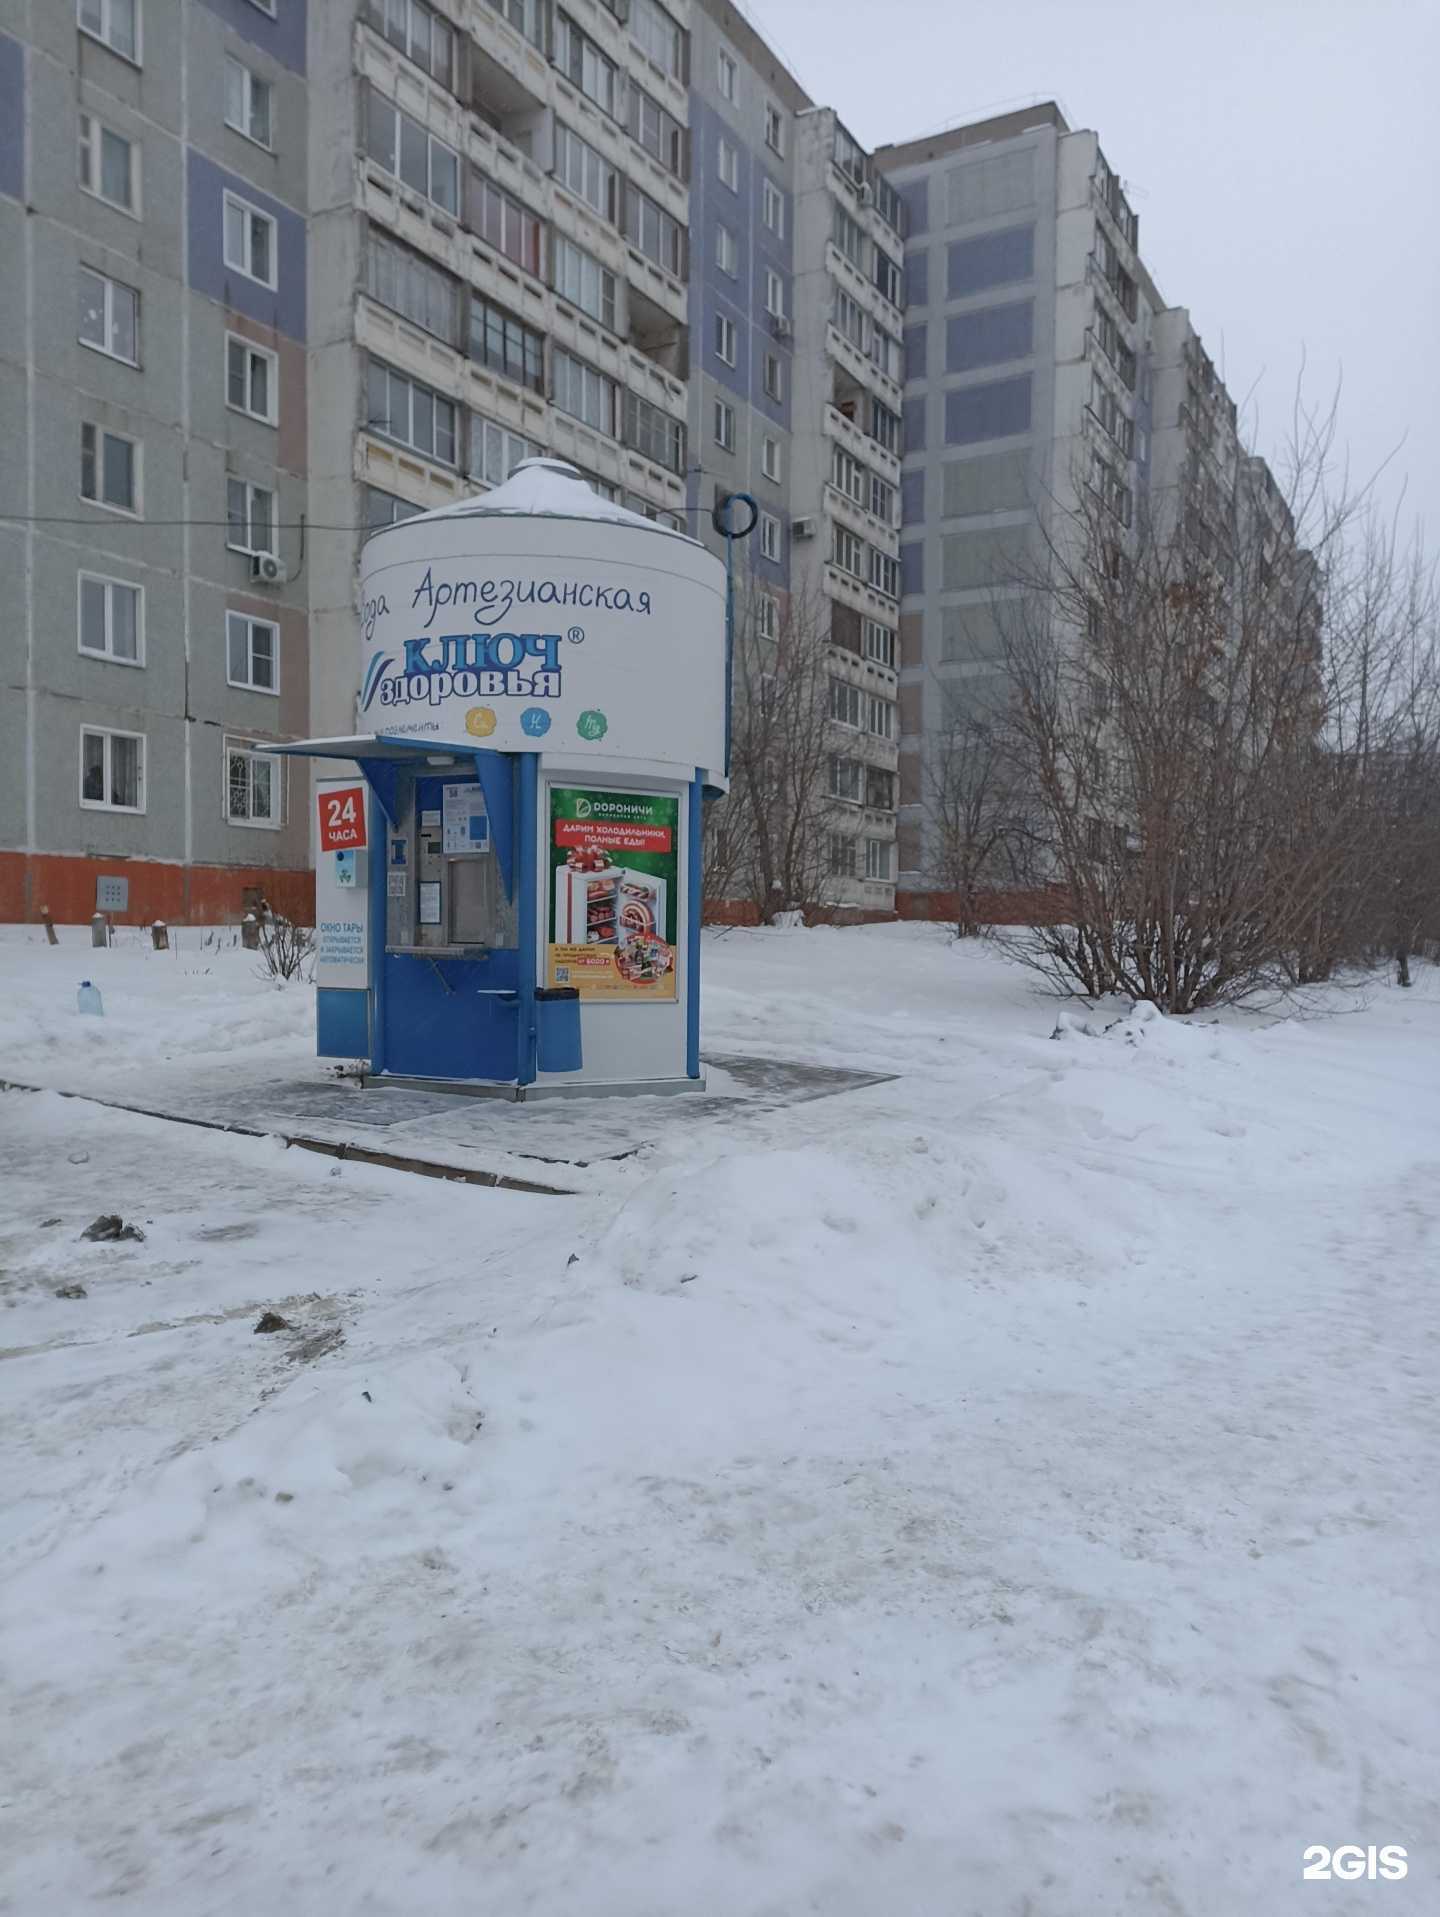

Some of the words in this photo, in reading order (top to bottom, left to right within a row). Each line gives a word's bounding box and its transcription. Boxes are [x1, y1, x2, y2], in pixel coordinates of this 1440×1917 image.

[361, 595, 390, 641] ода
[411, 566, 652, 628] Артезианская
[403, 633, 562, 673] КЛЮЧ
[326, 796, 357, 828] 24
[328, 828, 358, 842] ЧАСА
[563, 823, 594, 833] ДАРИМ
[584, 834, 621, 845] ПОЛНЫЕ
[320, 922, 341, 933] ОКНО
[343, 922, 364, 933] ТАРЫ
